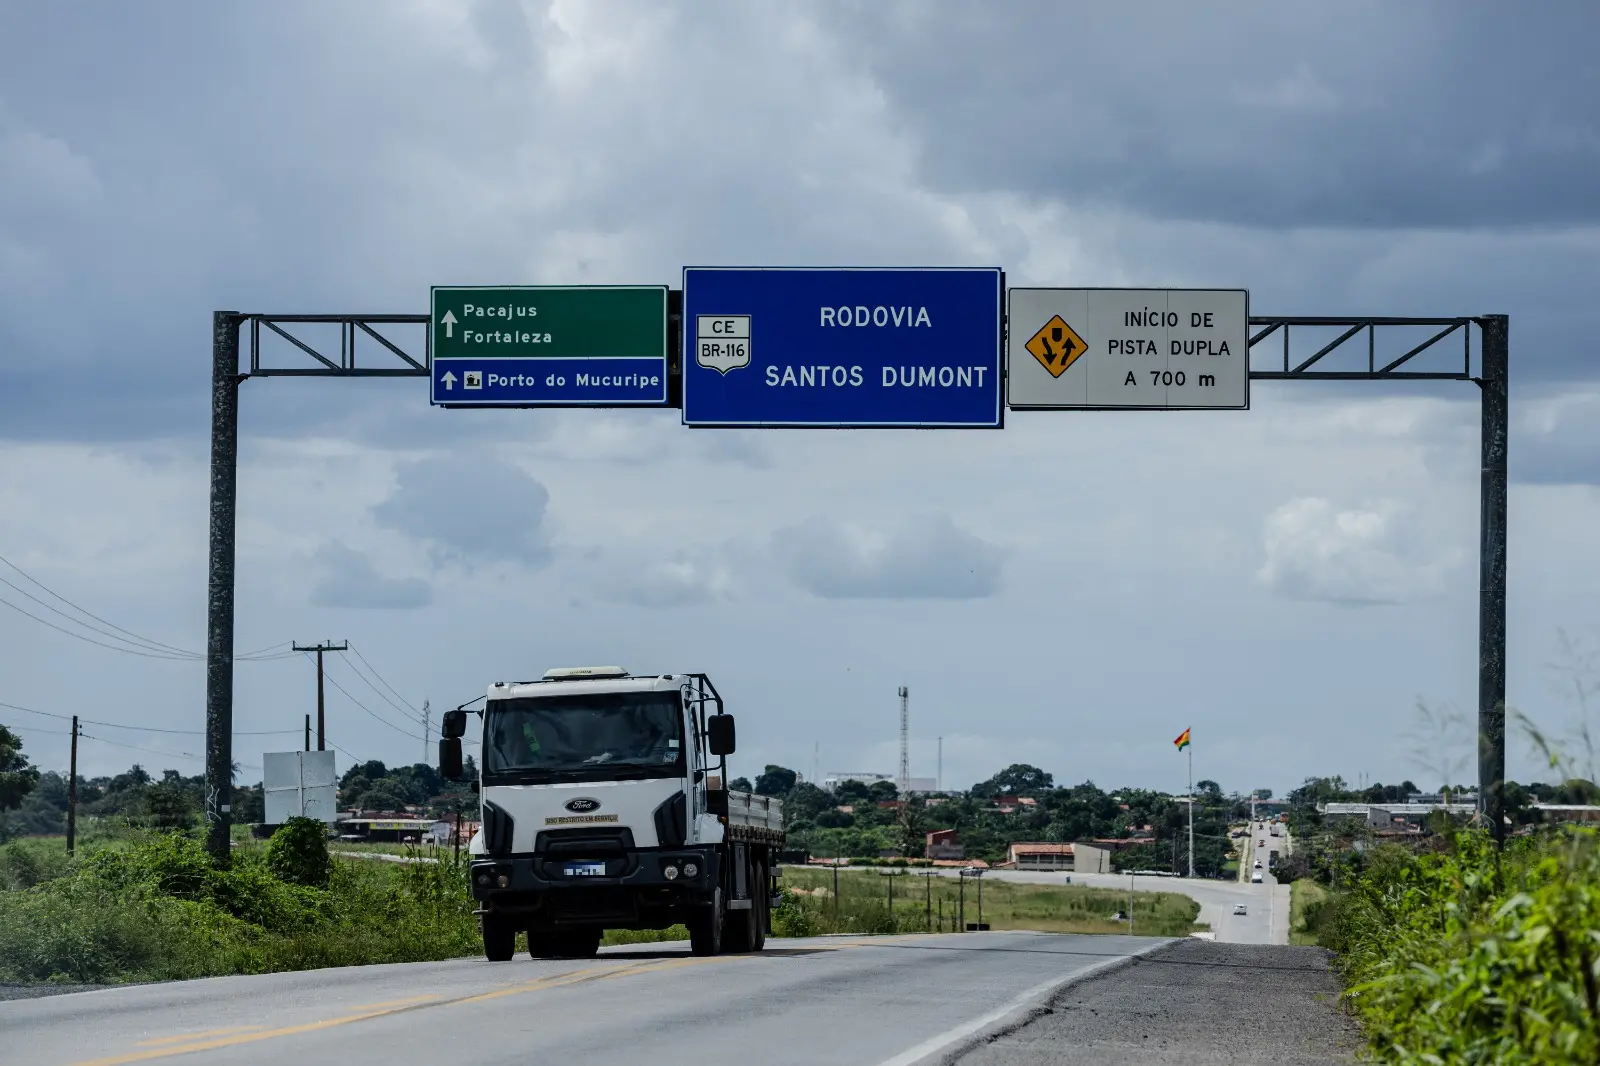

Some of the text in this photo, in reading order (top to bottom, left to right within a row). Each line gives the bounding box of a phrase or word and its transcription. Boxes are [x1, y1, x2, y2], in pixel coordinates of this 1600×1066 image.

[463, 304, 537, 320] Pacajus
[820, 306, 932, 327] RODOVIA
[1124, 307, 1214, 328] INÍCIO DE
[712, 320, 735, 334] CE
[463, 330, 552, 343] Fortaleza
[701, 343, 745, 357] BR-116
[1108, 339, 1230, 356] PISTA DUPLA
[488, 373, 660, 389] Porto do Mucuripe
[765, 365, 987, 387] SANTOS DUMONT
[1124, 371, 1215, 387] A 700 m
[572, 800, 592, 809] Ford
[558, 816, 585, 824] RESTRITO
